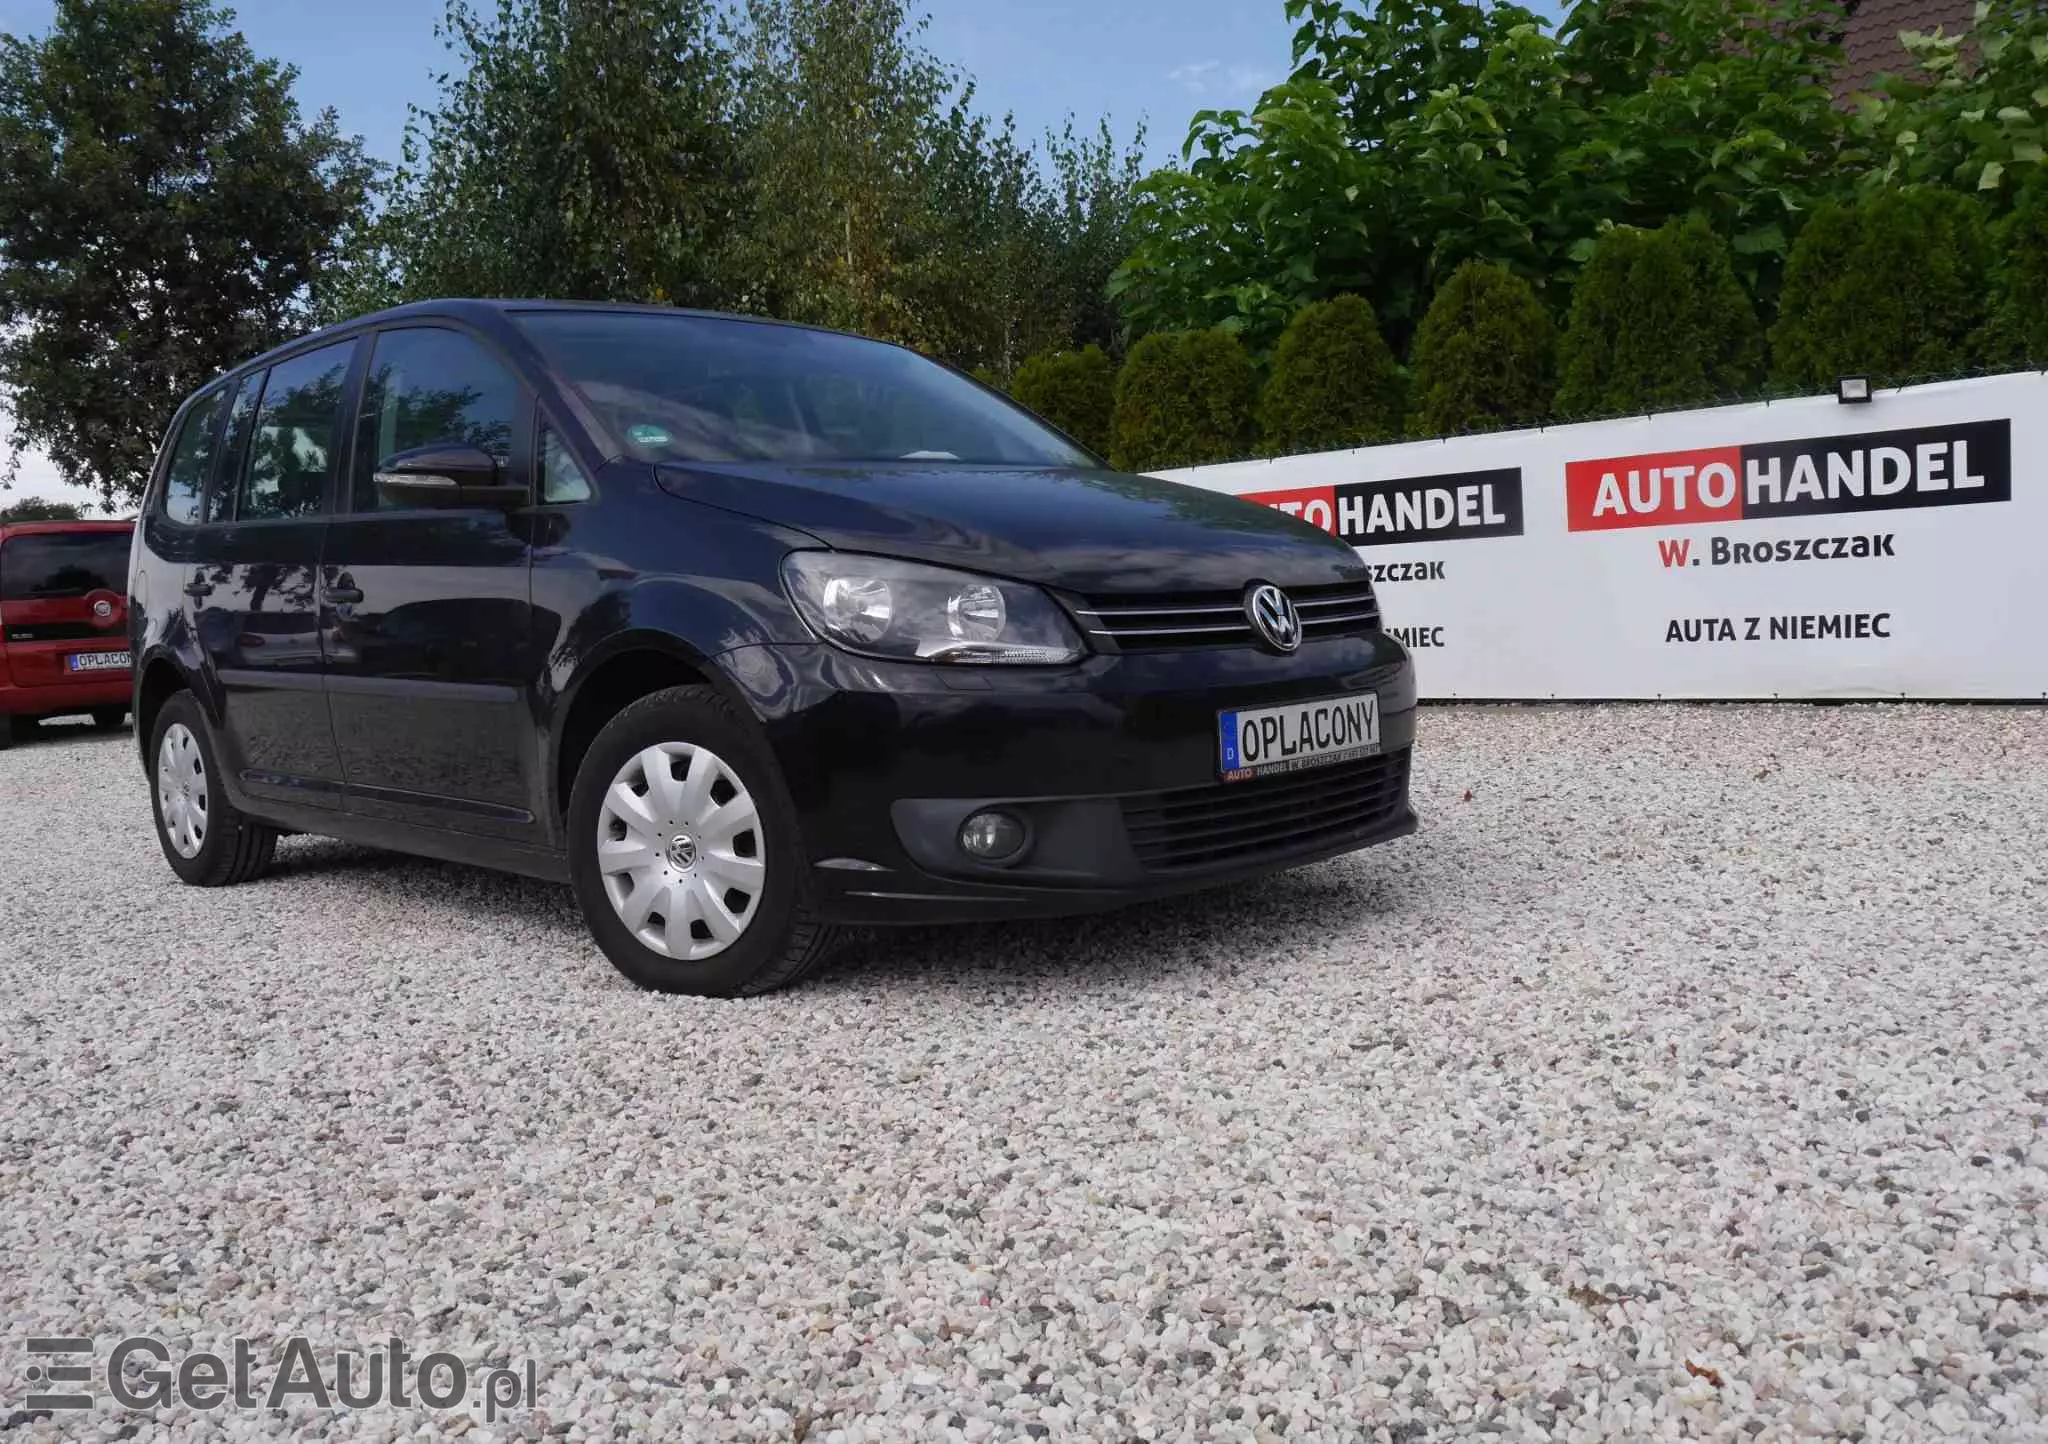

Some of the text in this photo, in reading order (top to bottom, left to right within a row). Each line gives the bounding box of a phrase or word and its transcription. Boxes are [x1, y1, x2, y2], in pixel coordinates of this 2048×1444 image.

[1658, 538, 1701, 568] W.
[1665, 612, 1891, 643] AUTA Z NIEMIEC
[1242, 700, 1375, 762] OPLACONY
[1227, 768, 1253, 782] AUTO
